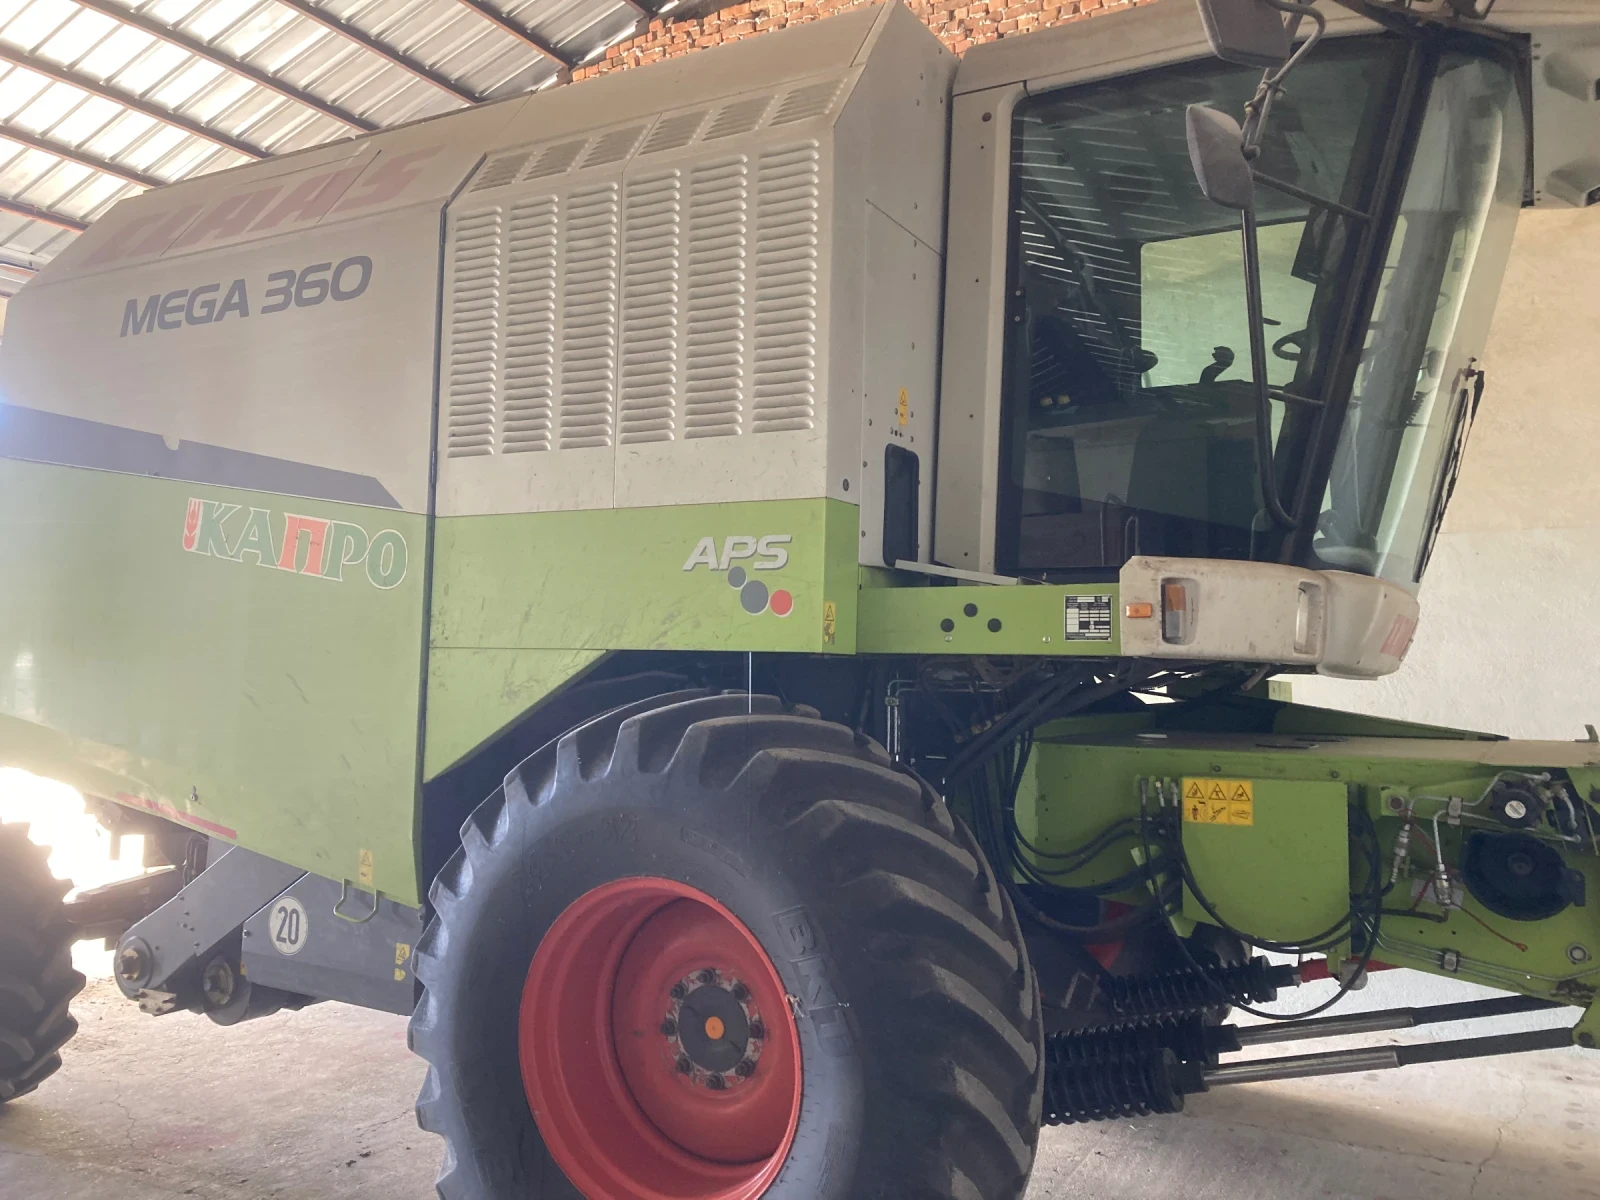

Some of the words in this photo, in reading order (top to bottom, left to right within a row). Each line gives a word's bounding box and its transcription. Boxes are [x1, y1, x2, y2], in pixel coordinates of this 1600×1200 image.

[78, 145, 445, 267] CLAAS
[120, 279, 249, 337] MEGA
[260, 256, 373, 314] 360
[183, 497, 408, 589] КАПРО
[683, 534, 792, 571] APS
[277, 906, 299, 945] 20
